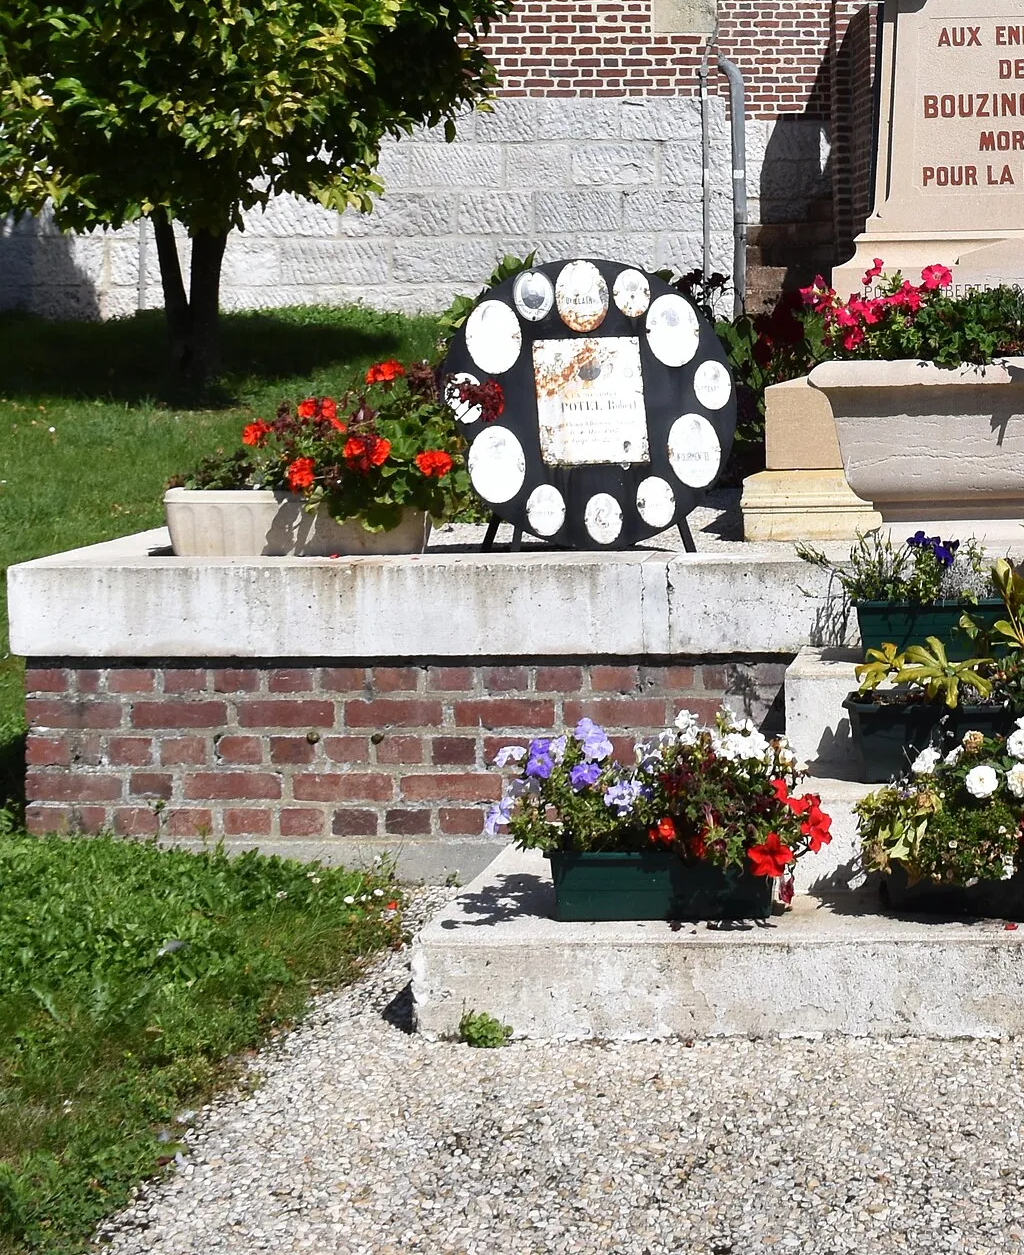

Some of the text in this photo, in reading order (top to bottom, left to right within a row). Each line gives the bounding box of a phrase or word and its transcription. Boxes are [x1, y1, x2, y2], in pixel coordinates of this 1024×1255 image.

[937, 26, 982, 47] AUX
[922, 165, 978, 187] POUR
[987, 164, 1014, 185] LA
